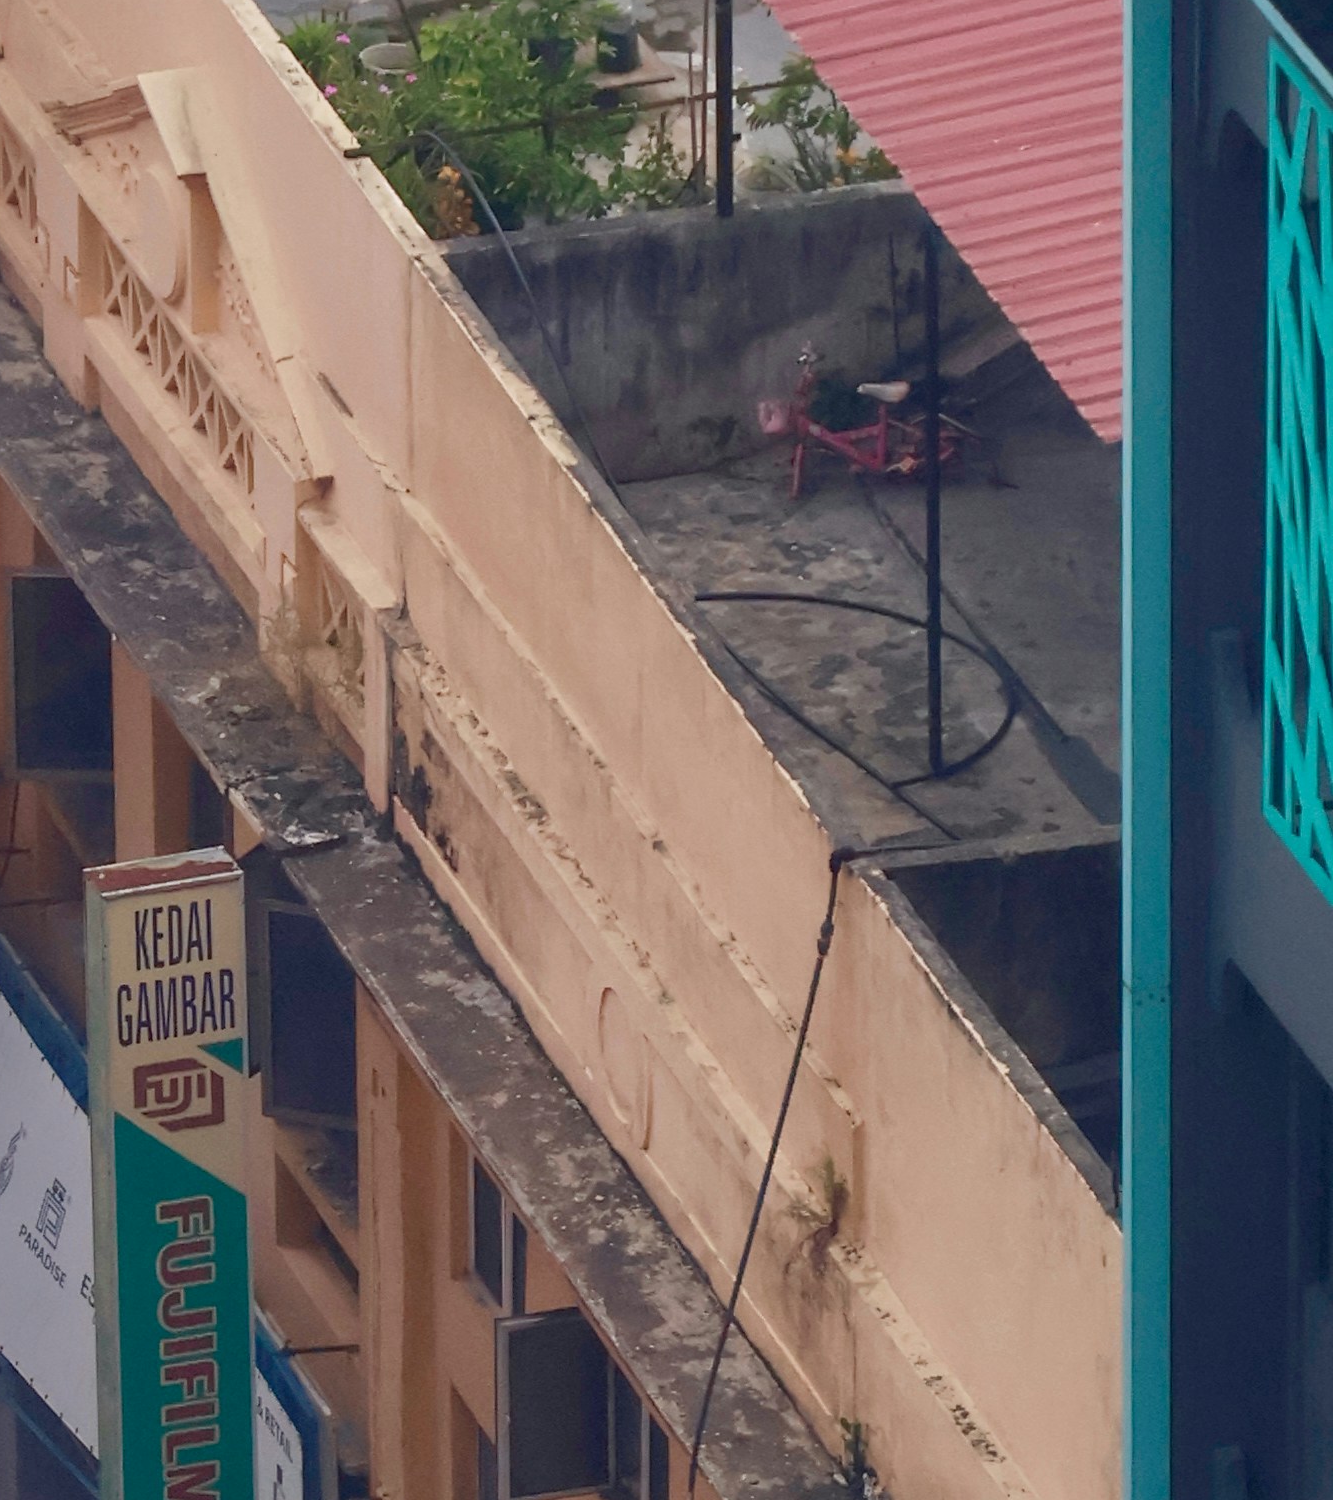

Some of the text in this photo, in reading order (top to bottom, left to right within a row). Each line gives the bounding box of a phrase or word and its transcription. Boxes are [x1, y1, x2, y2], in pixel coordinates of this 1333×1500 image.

[135, 899, 213, 971] KEDAI
[117, 969, 236, 1048] GAMBAR
[18, 1225, 68, 1290] PARADISE
[265, 1409, 294, 1464] RETAIL
